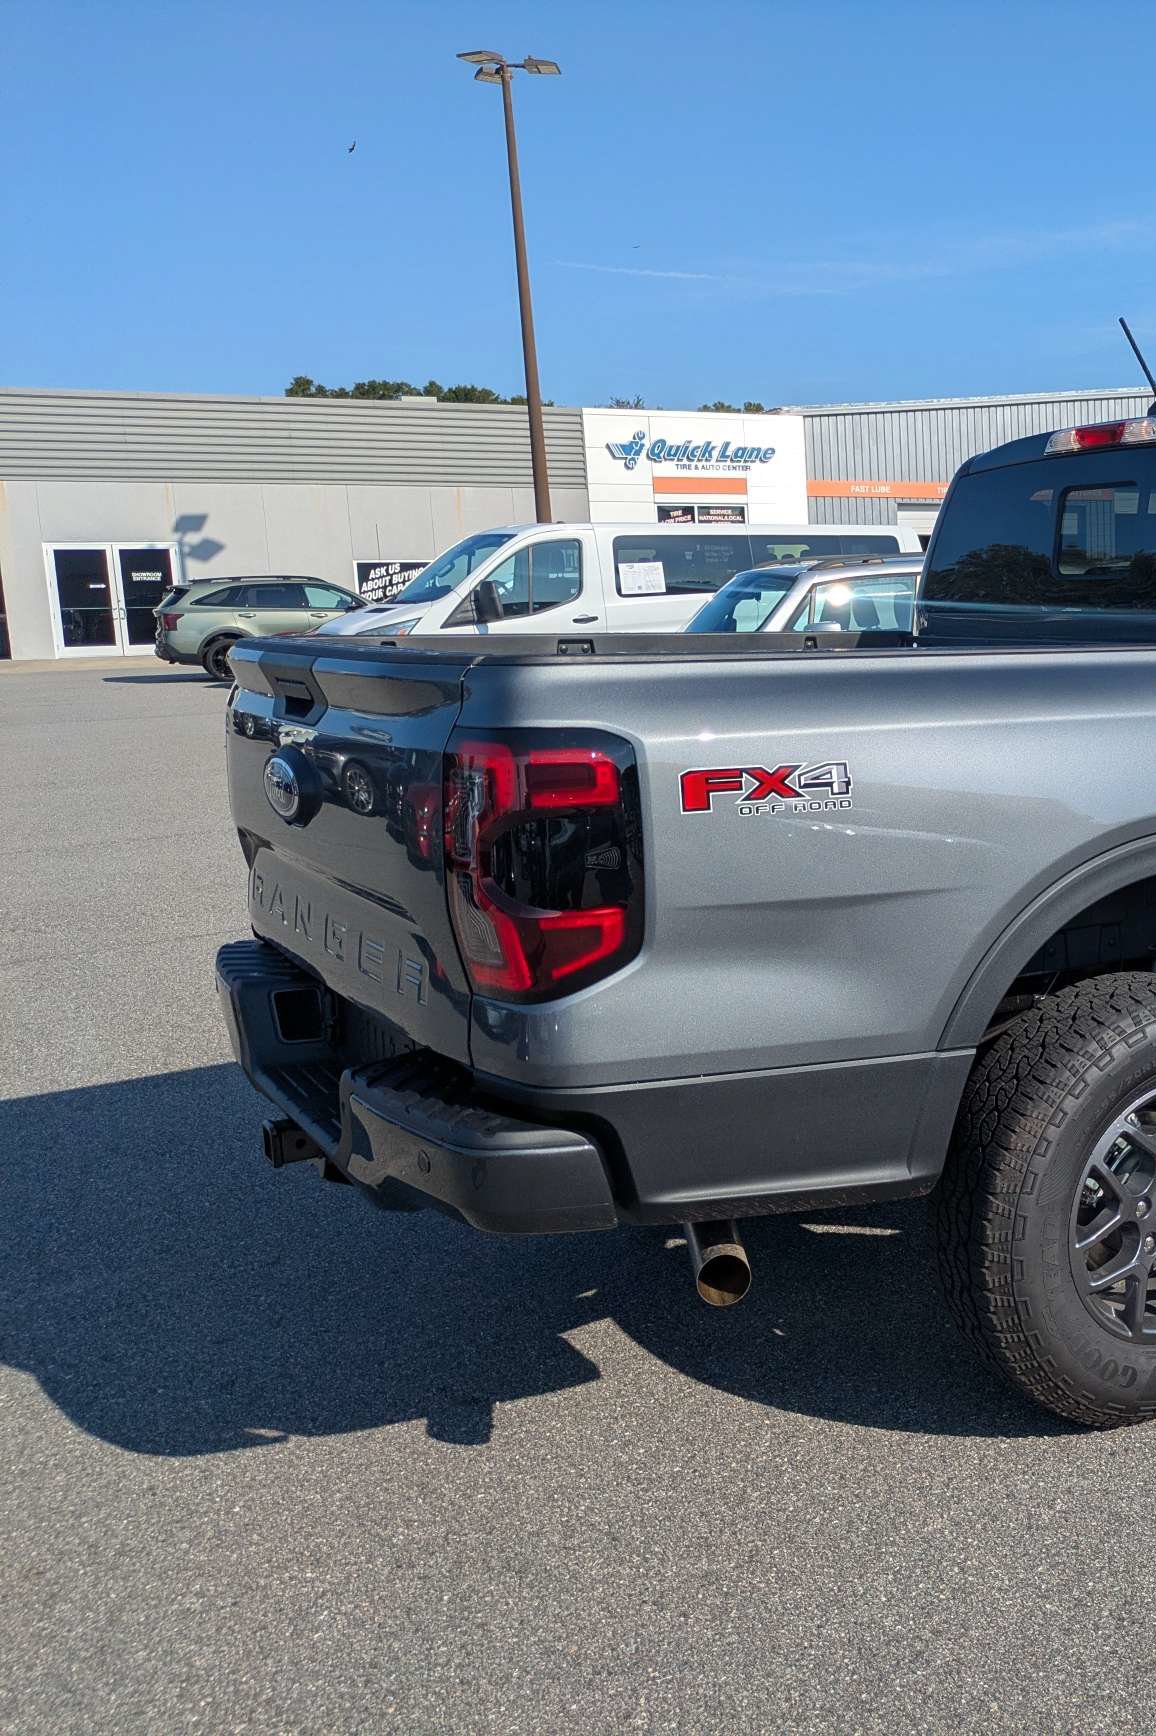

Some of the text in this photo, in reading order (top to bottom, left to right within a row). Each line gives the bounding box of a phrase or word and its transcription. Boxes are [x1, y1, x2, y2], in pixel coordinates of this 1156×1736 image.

[646, 438, 776, 463] Quick Lane
[675, 463, 692, 471] TIRE
[722, 464, 751, 472] CENTER
[850, 485, 869, 493] FAST
[872, 485, 891, 493] LUBE
[369, 563, 400, 580] ASK US
[361, 576, 391, 592] ABOUT
[678, 760, 852, 815] FX4
[738, 799, 852, 816] OFF ROAD
[251, 867, 431, 1007] RANGER
